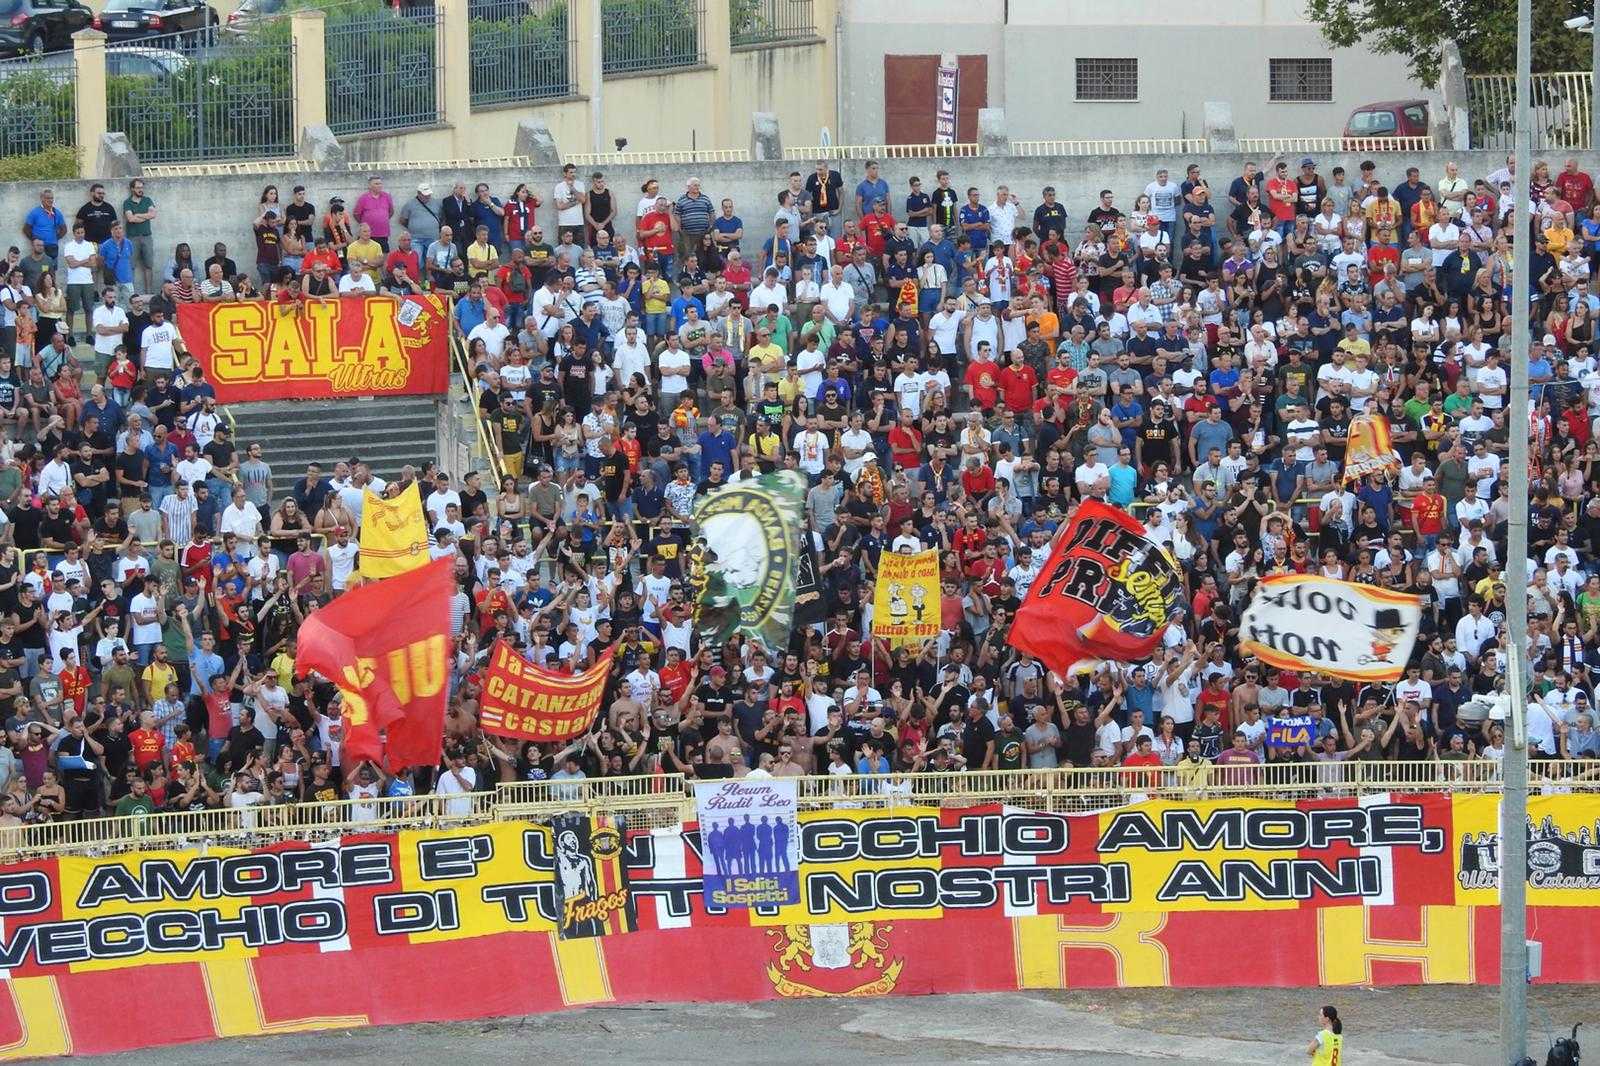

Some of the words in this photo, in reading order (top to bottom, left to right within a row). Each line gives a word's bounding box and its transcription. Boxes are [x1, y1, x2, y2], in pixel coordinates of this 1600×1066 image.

[210, 296, 410, 384] SALA
[329, 362, 407, 392] Ultras
[1271, 727, 1311, 744] FILA
[704, 795, 753, 811] Rudit
[757, 794, 792, 808] Leo
[78, 843, 395, 909] AMORE
[418, 835, 494, 880] E'
[1096, 803, 1443, 855] AMORE,
[373, 890, 460, 936] DI
[806, 864, 1131, 915] NOSTRI
[1157, 857, 1382, 903] ANNI
[734, 876, 779, 892] Soliti
[711, 887, 789, 907] Sospetti
